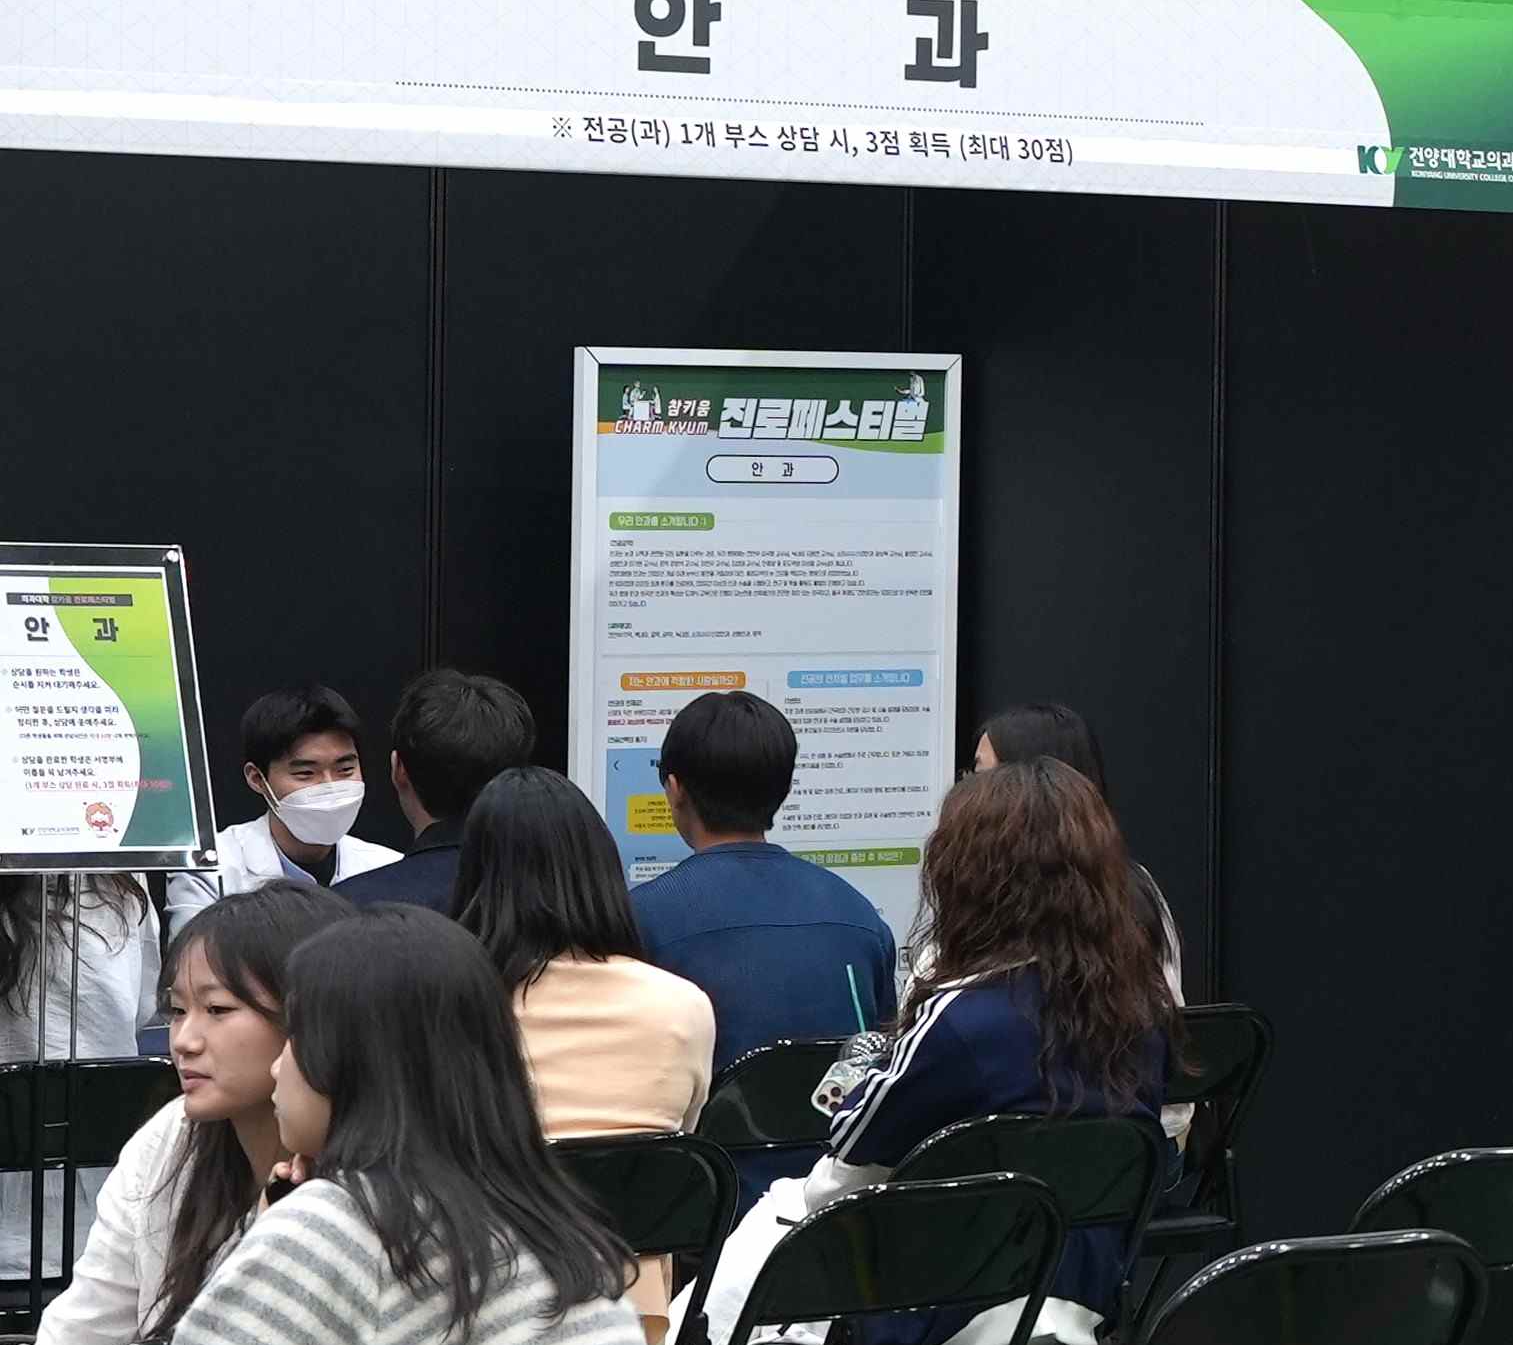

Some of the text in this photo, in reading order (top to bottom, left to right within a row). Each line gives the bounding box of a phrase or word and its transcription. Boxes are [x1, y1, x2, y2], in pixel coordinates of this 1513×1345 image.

[584, 117, 669, 148] 전공(과)
[681, 122, 715, 147] 1개
[725, 124, 768, 148] 부스
[778, 126, 819, 151] 상담
[830, 129, 857, 157] 시,
[867, 131, 899, 155] 3점
[910, 132, 950, 158] 획득
[961, 135, 1009, 161] (최대
[1018, 139, 1072, 166] 30점)
[668, 399, 711, 417] 참키움
[718, 397, 929, 441] 진로페스티벌
[614, 421, 709, 435] CHARM KYUM
[751, 462, 794, 478] 안 과
[24, 616, 118, 642] 안 과
